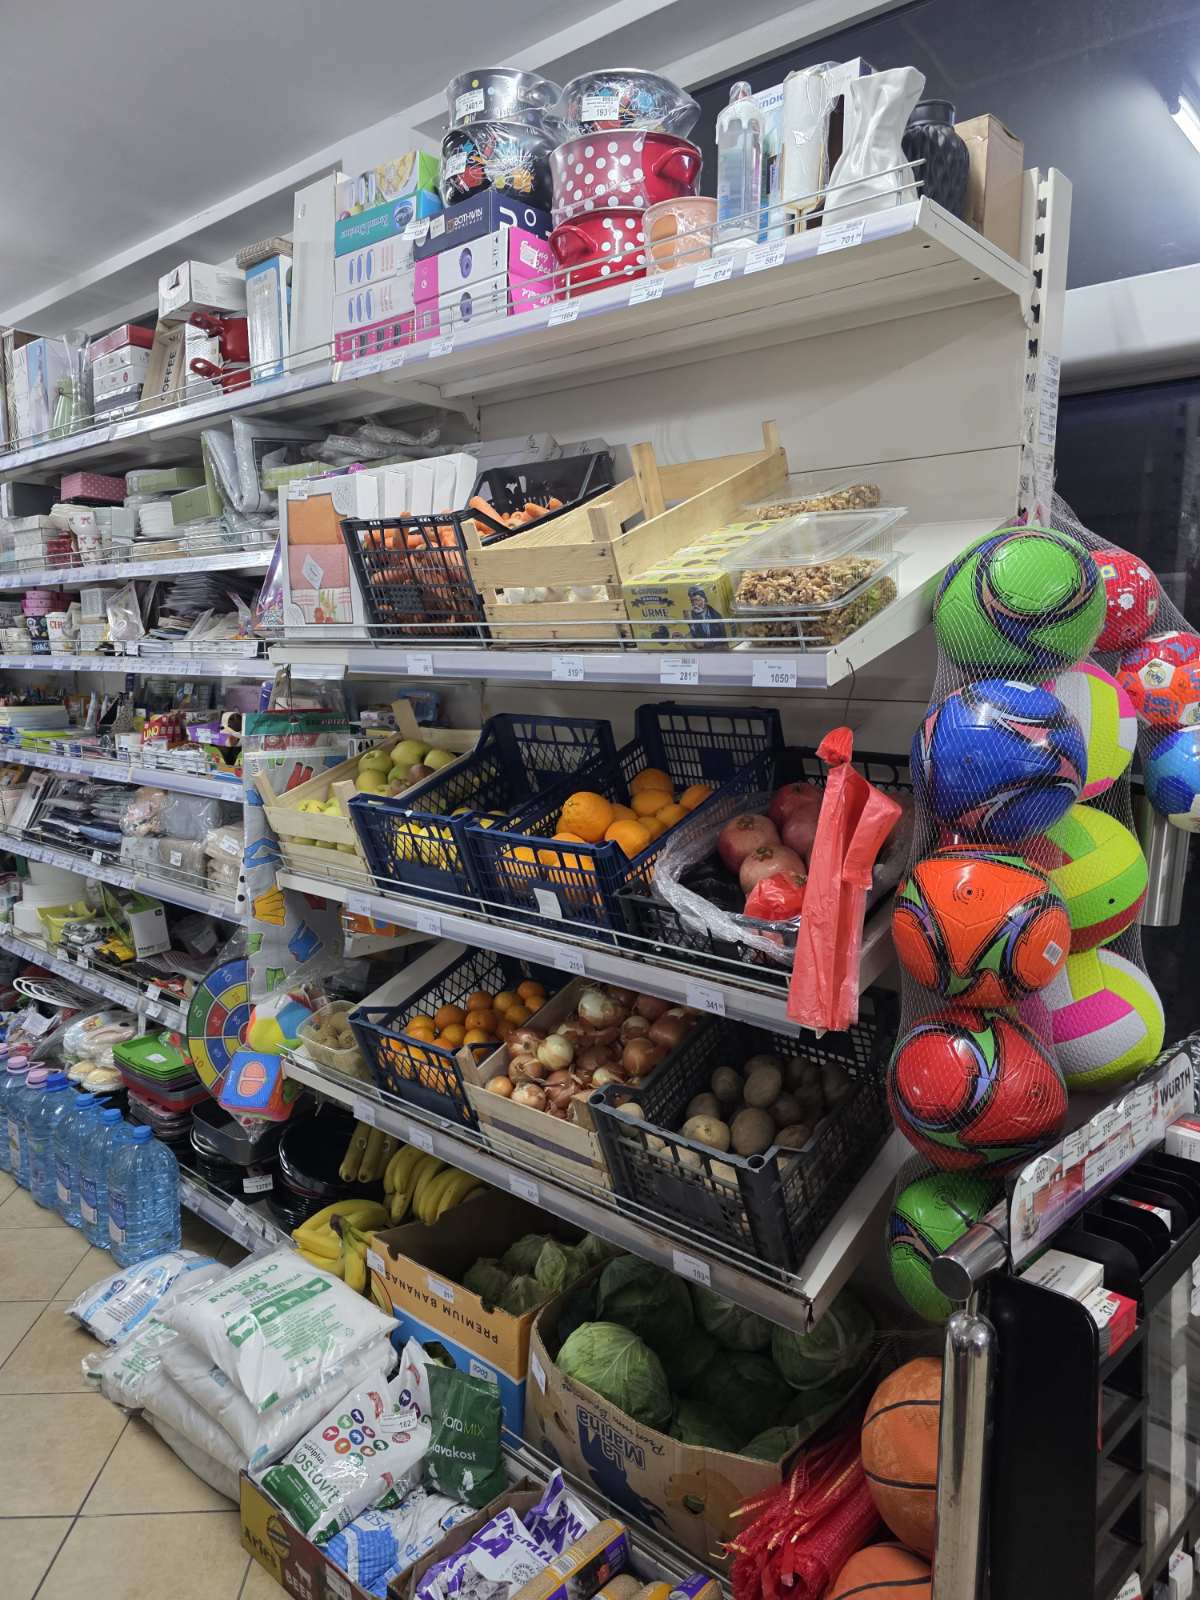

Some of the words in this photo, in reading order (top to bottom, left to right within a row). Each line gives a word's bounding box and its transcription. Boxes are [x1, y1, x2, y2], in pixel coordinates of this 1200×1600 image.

[770, 673, 789, 684] 1050
[221, 968, 233, 982] 10
[192, 1005, 203, 1018] 10
[385, 1271, 437, 1308] BANANAS
[442, 1306, 499, 1345] PREMIUM
[577, 1405, 646, 1471] Marina
[600, 1440, 626, 1471] La
